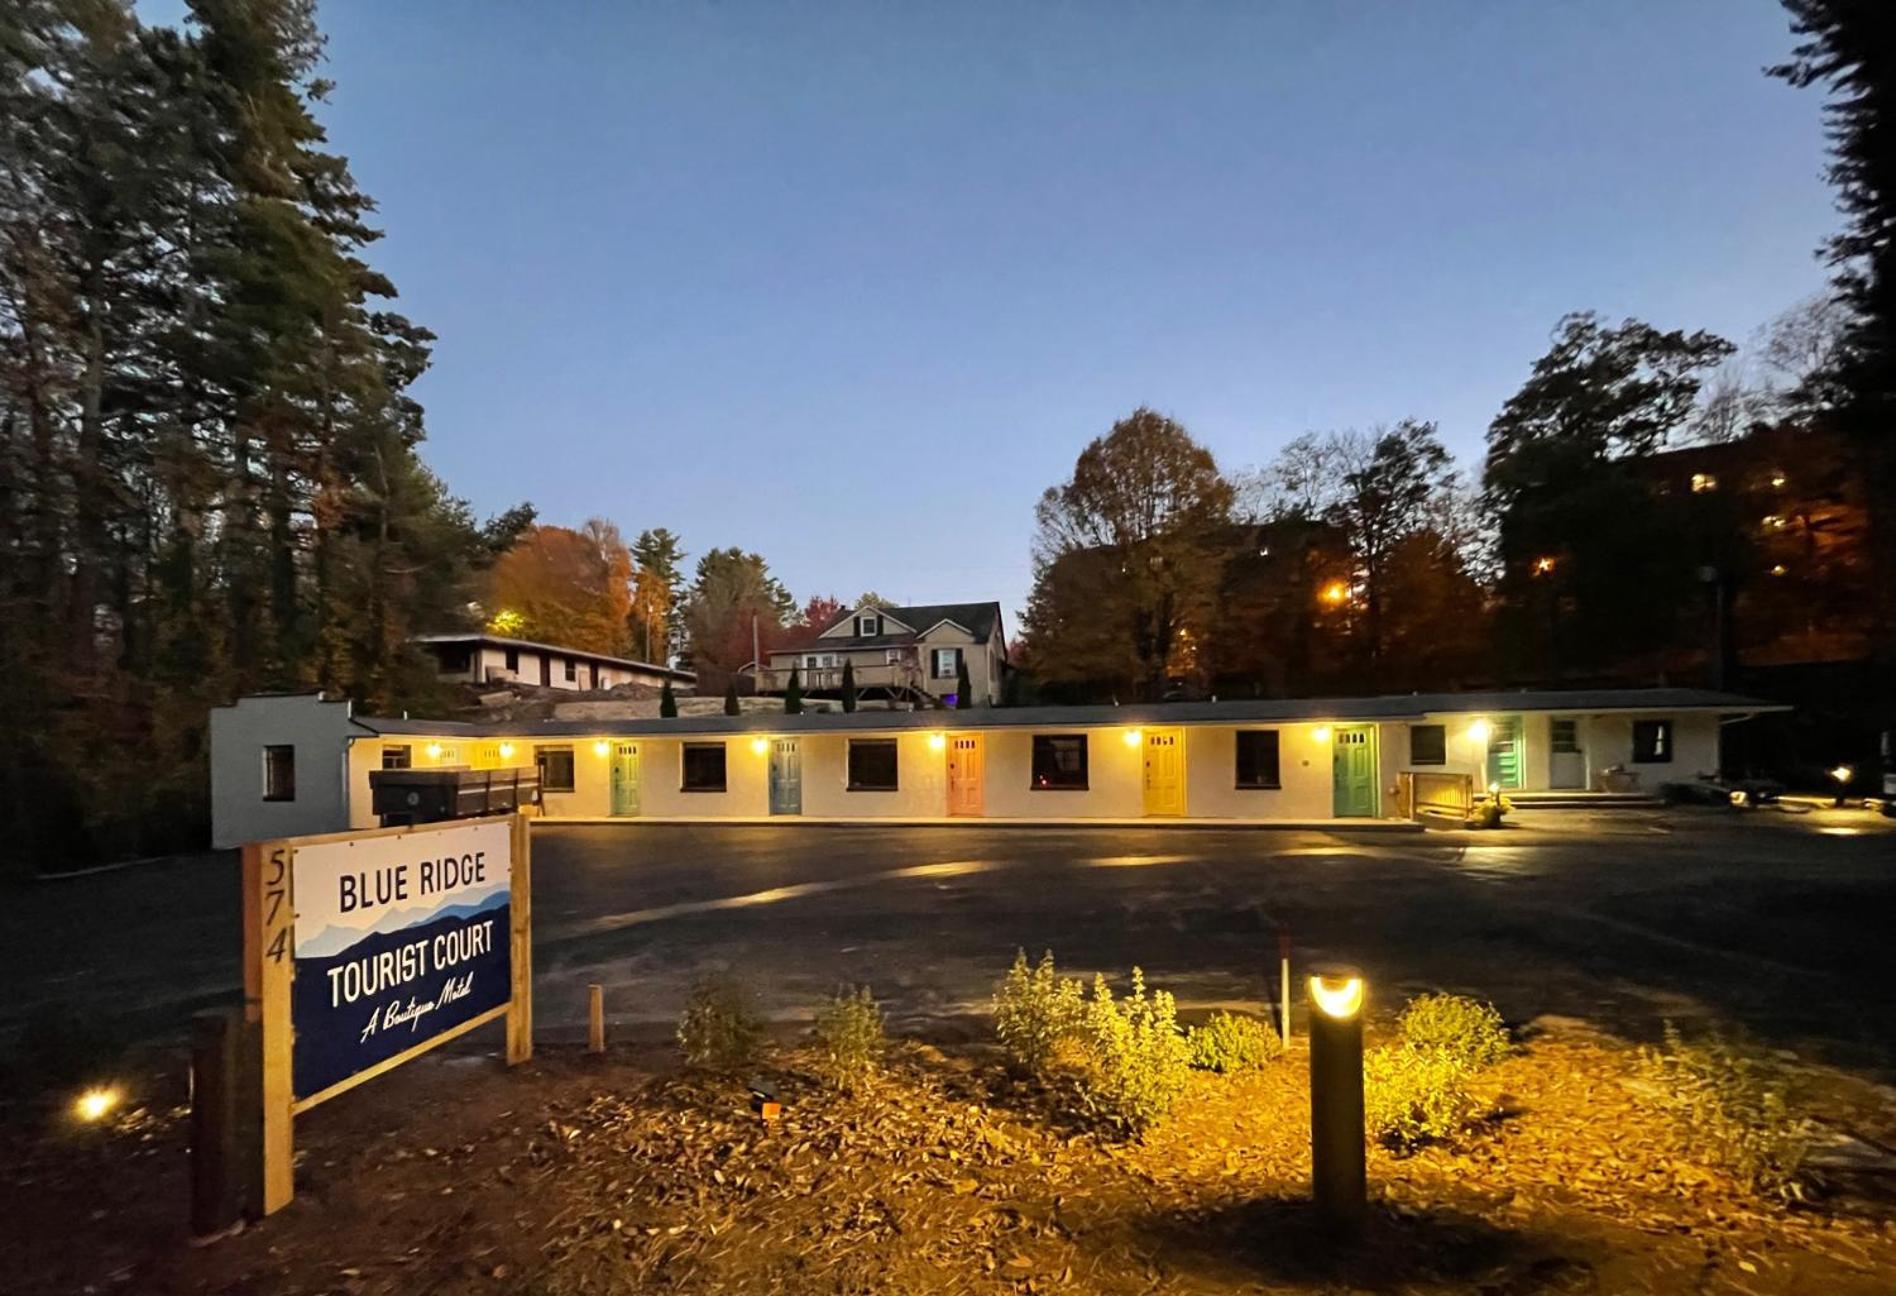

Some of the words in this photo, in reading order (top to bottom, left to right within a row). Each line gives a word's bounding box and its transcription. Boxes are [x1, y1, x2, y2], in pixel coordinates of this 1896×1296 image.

[265, 849, 287, 964] 574
[340, 865, 408, 913] BLUE
[420, 852, 486, 896] RIDGE
[327, 939, 429, 1008] TOURIST
[434, 920, 494, 970] COURT
[360, 1008, 379, 1044] A
